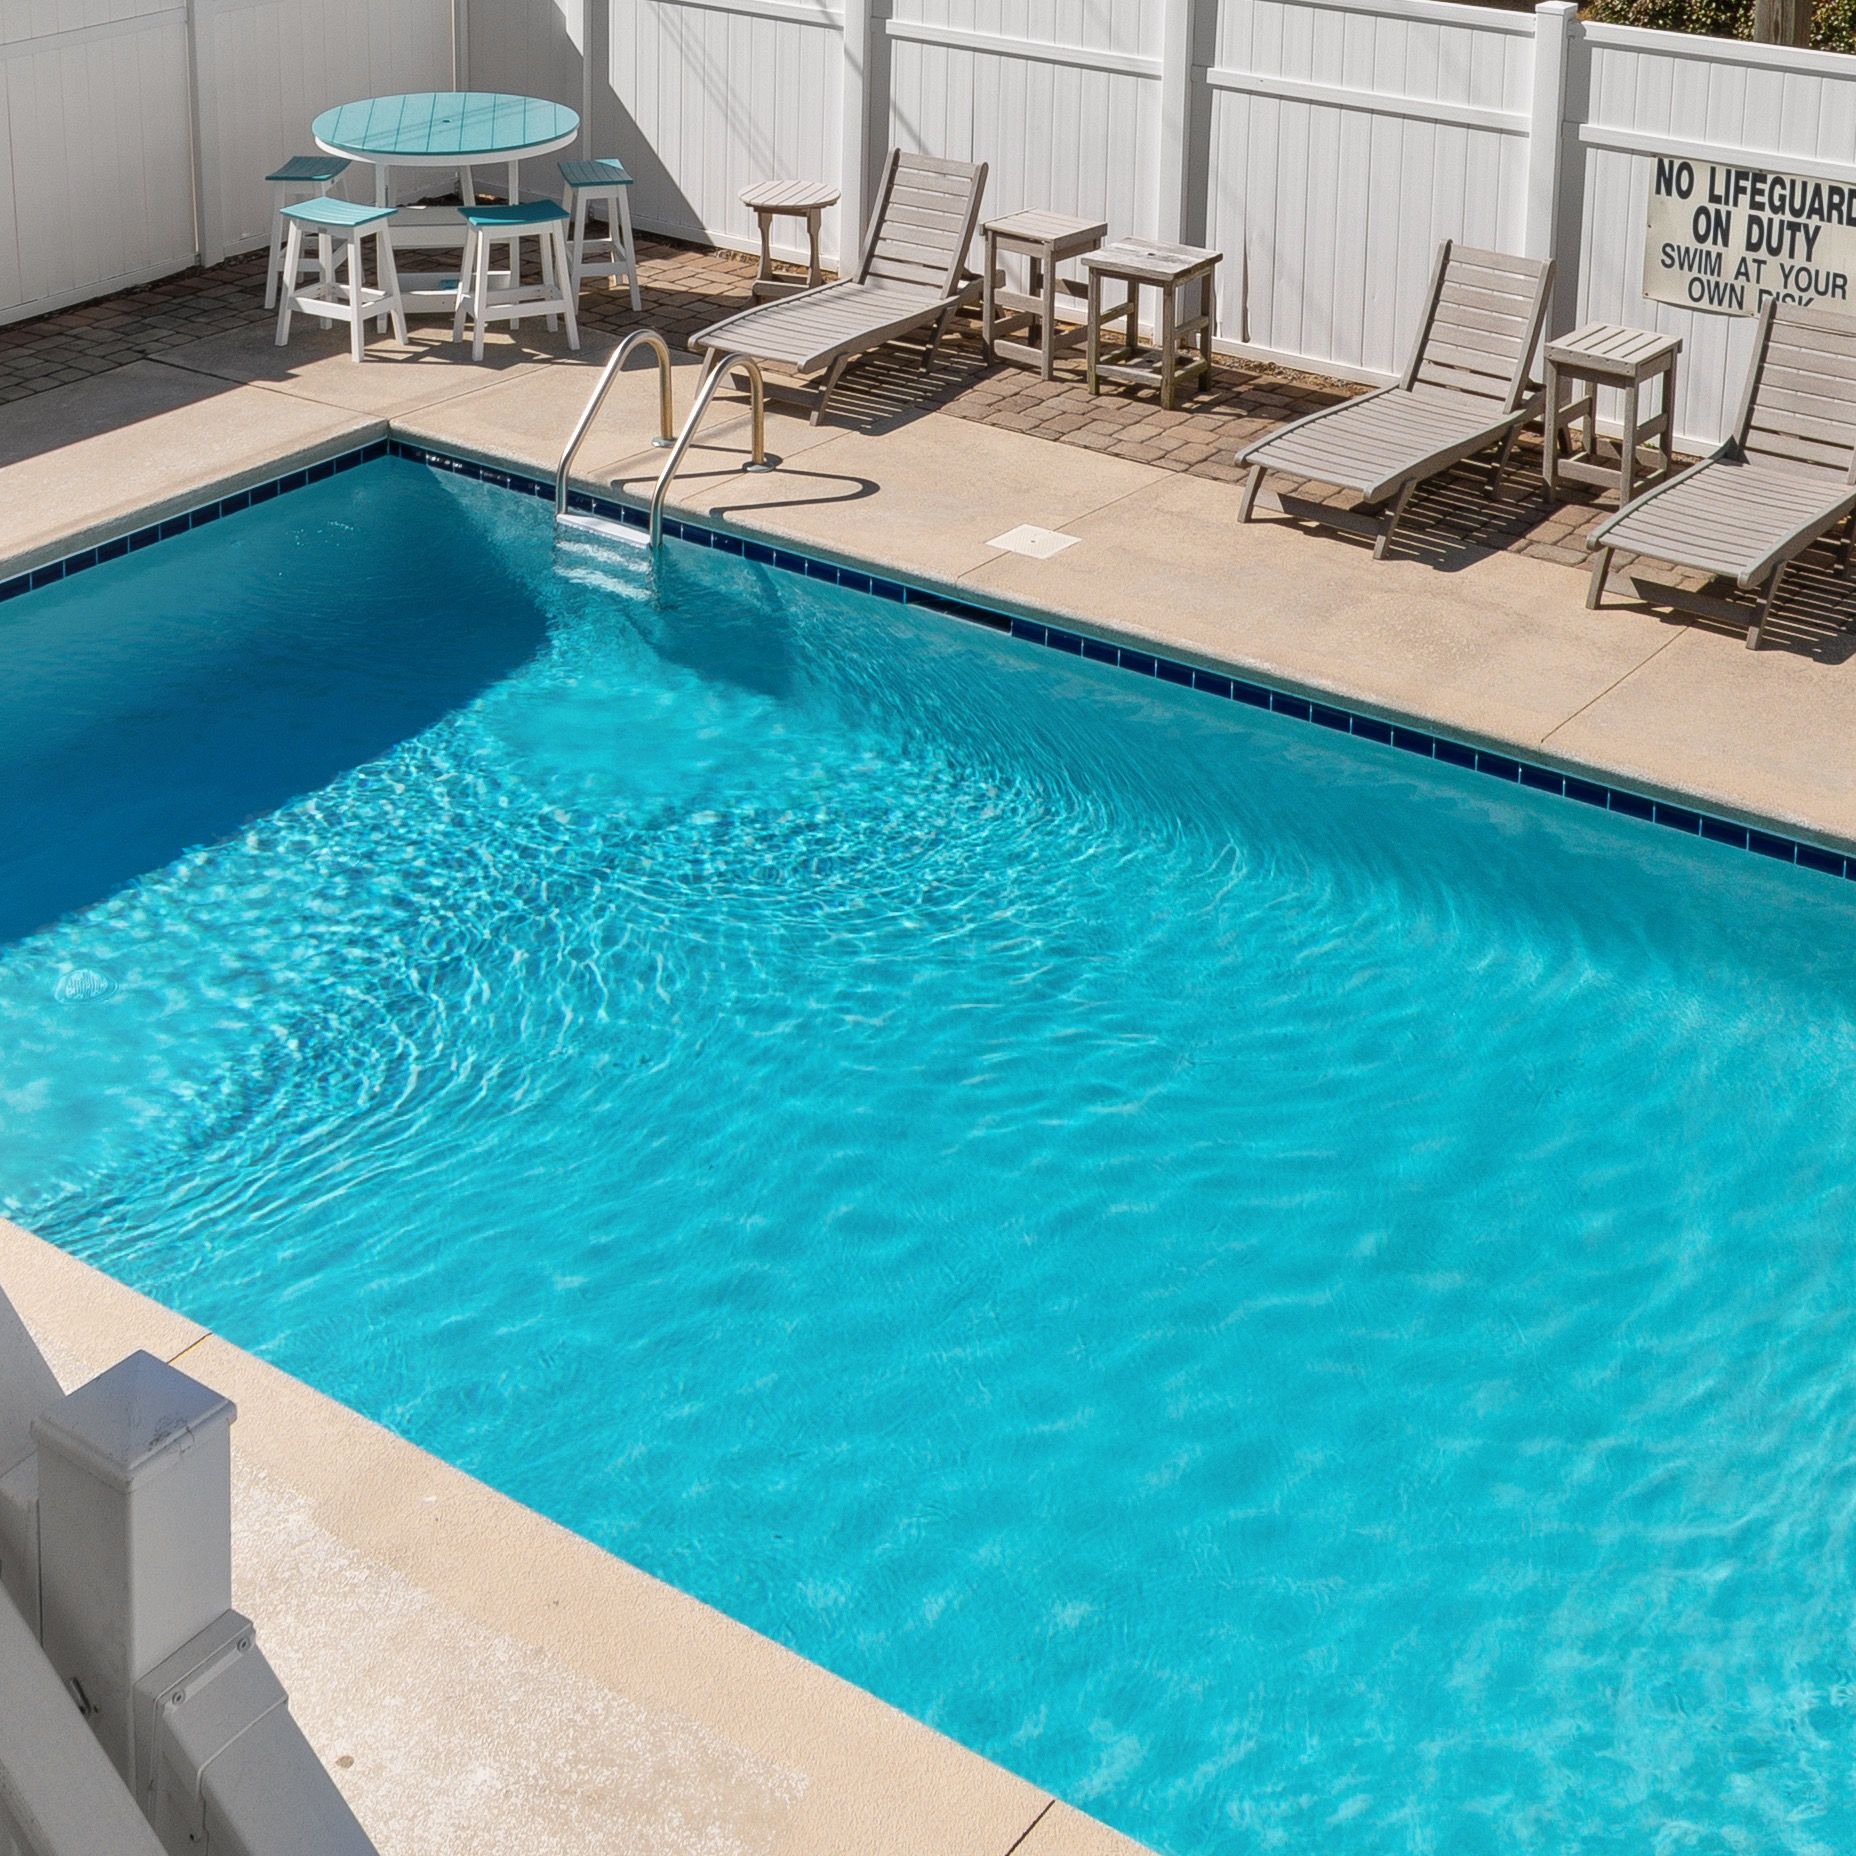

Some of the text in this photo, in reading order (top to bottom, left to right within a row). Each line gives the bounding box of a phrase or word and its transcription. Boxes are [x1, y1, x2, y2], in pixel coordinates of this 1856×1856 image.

[1655, 158, 1694, 199] NO
[1692, 205, 1822, 262] ON DUTY
[1661, 243, 1848, 300] SWIM AT YOUR
[1688, 276, 1744, 310] OWN
